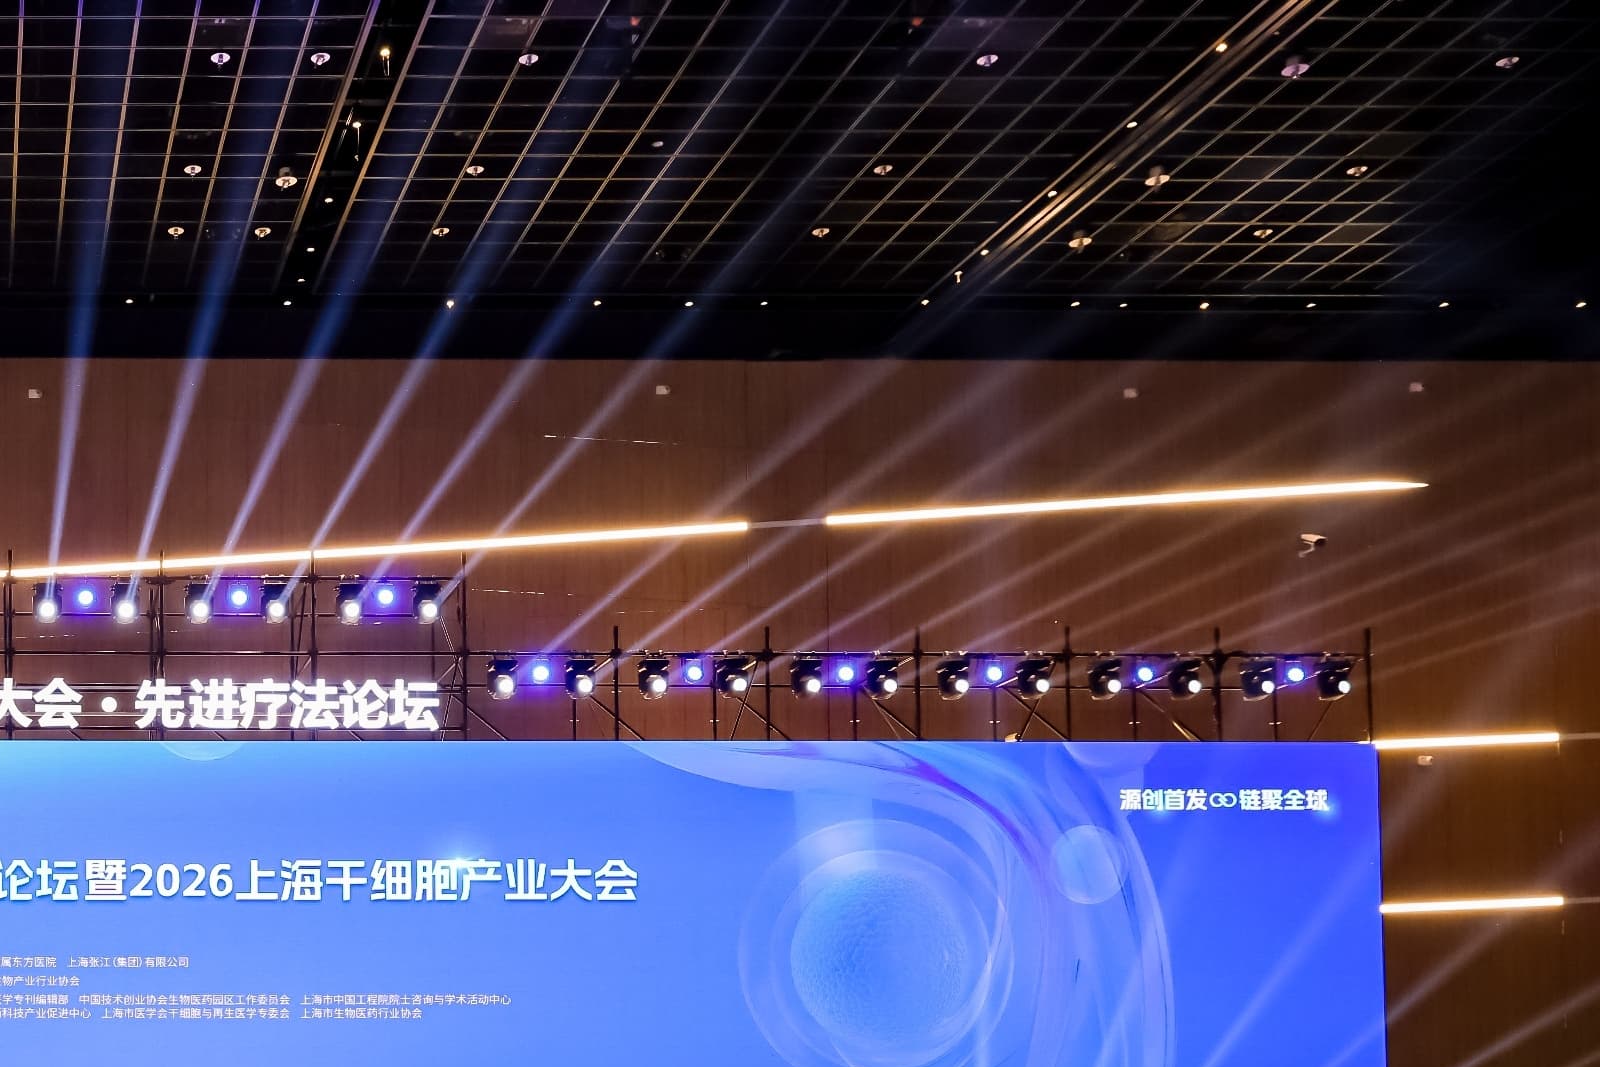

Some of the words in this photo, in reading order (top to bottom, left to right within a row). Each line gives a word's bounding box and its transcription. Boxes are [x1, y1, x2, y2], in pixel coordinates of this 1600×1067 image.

[1119, 789, 1208, 811] 源创首发
[1239, 789, 1330, 811] 链聚全球
[79, 994, 290, 1006] 中国技术创业协会生物医药园区工作委员会
[101, 1007, 290, 1019] 上海市医学会干细胞与再生医学专委会
[300, 1007, 422, 1019] 上海市生物医药行业协会
